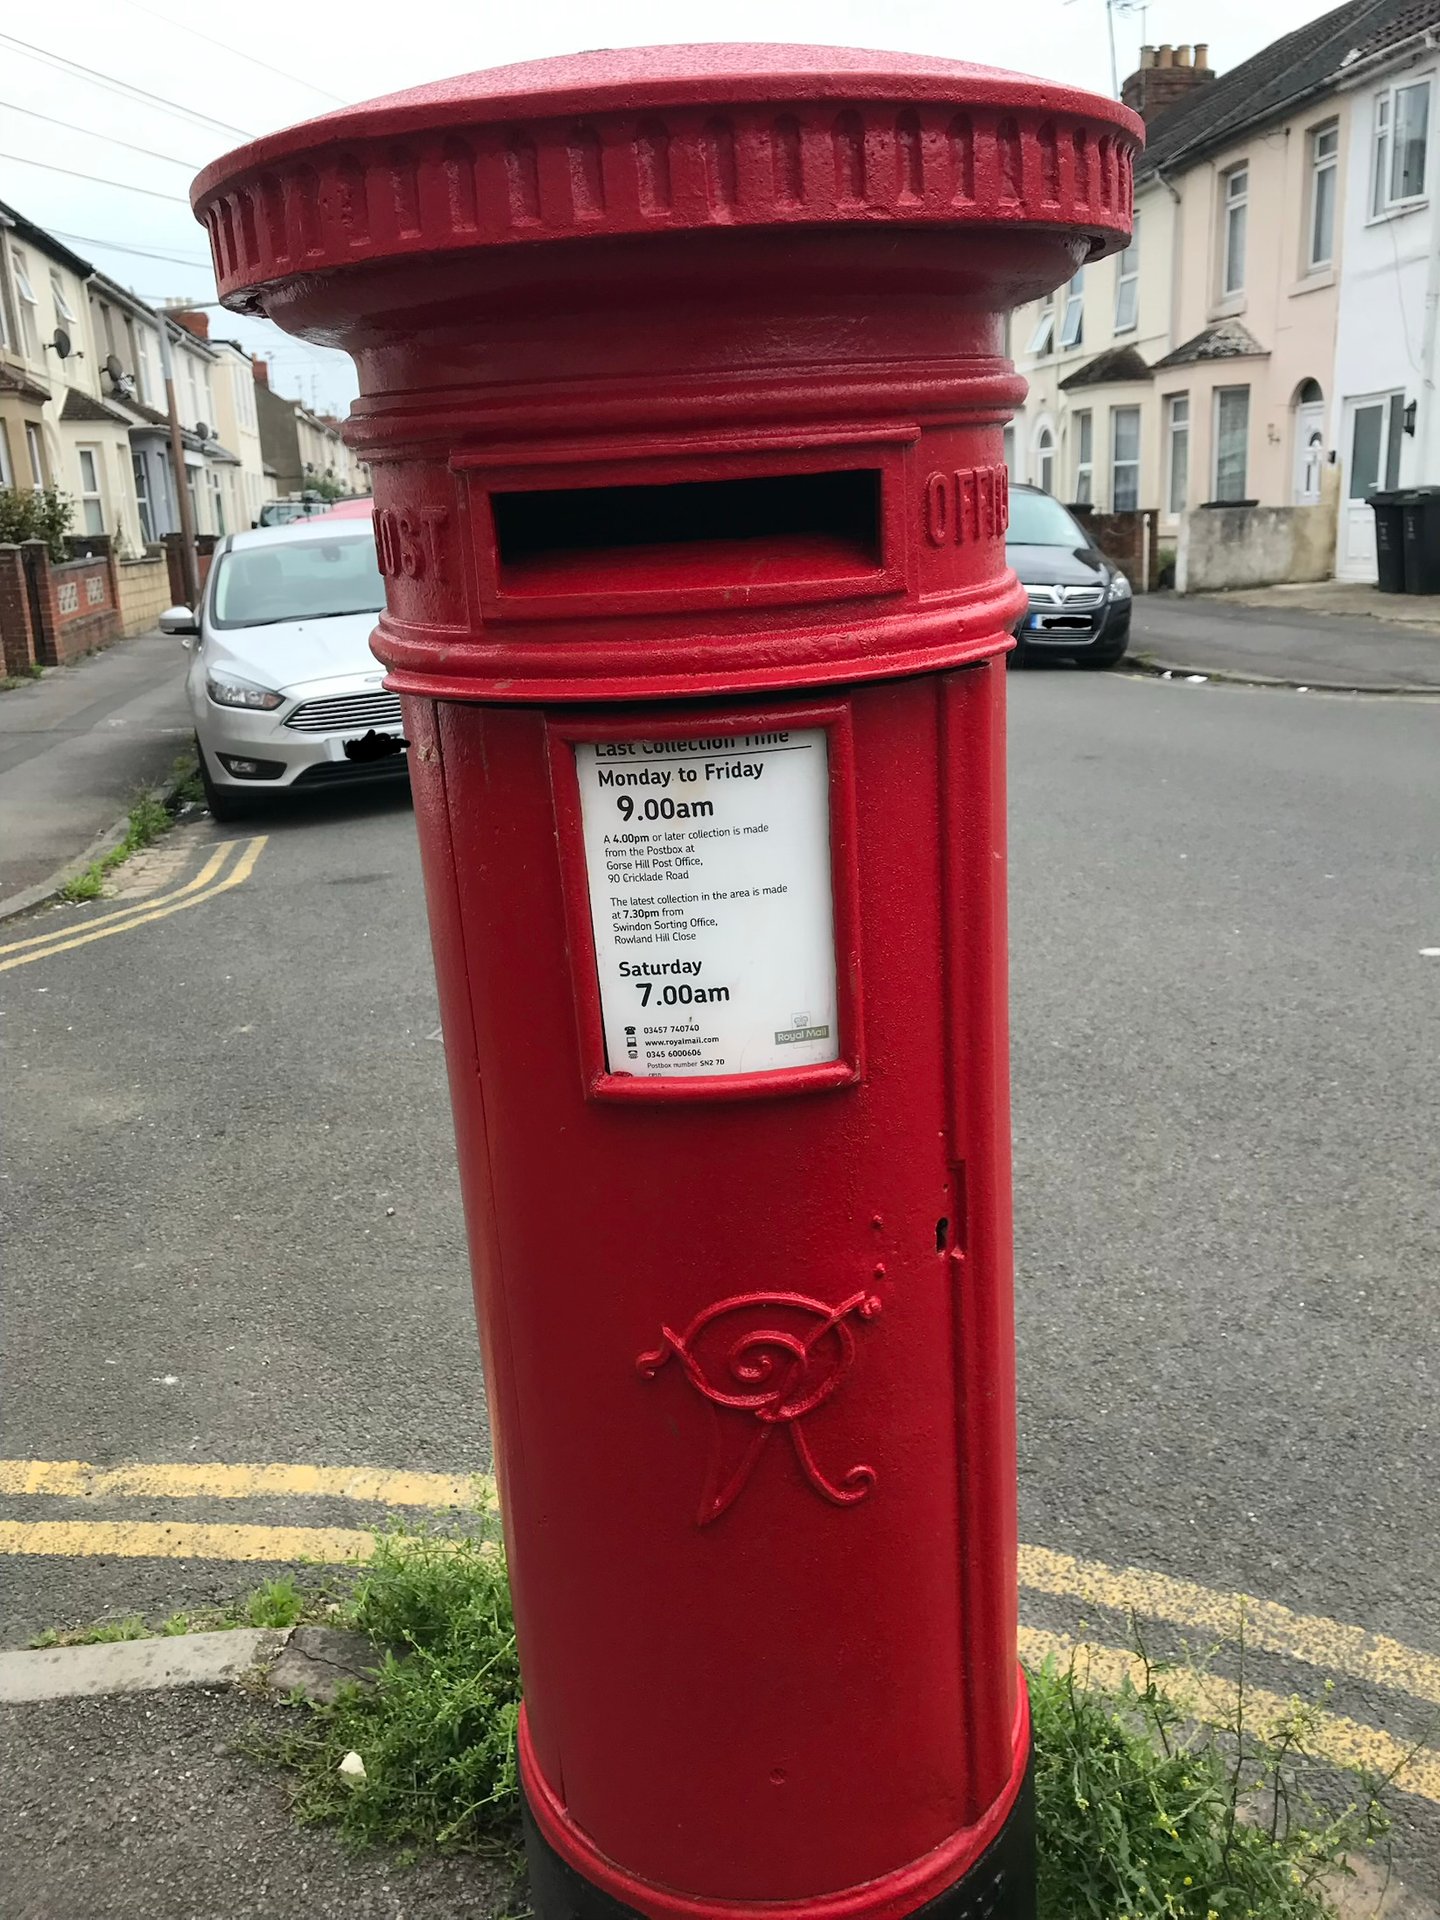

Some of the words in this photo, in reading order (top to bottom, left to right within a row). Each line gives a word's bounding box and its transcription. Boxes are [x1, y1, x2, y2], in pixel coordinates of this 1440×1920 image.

[372, 507, 446, 580] OST
[595, 741, 636, 757] Last
[642, 737, 735, 754] Collection
[598, 768, 671, 788] Monday
[678, 768, 697, 782] to
[705, 761, 764, 781] Friday
[616, 795, 714, 822] 9.00am
[604, 835, 610, 844] A
[613, 834, 650, 845] 4.00pm
[664, 832, 685, 842] later
[688, 828, 730, 840] collection
[733, 826, 740, 835] is
[744, 824, 769, 834] made
[605, 847, 626, 857] from
[630, 846, 644, 856] the
[647, 845, 683, 856] Postbox
[686, 844, 695, 853] at
[606, 860, 632, 870] Gorse
[635, 859, 650, 869] Hill
[652, 858, 672, 868] Post
[608, 874, 620, 884] 90
[622, 872, 664, 882] Cricklade
[666, 870, 689, 880] Road
[610, 897, 628, 906] The
[630, 896, 655, 906] latest
[657, 894, 699, 904] collection
[701, 892, 710, 901] in
[712, 891, 728, 900] the
[730, 889, 750, 899] area
[752, 887, 760, 896] is
[762, 884, 788, 895] made
[612, 912, 621, 920] at
[622, 908, 659, 920] 7.30pm
[662, 907, 684, 917] from
[613, 922, 652, 932] Swindon
[654, 919, 688, 930] Sorting
[614, 934, 652, 944] Rowland
[656, 933, 670, 943] Hill
[672, 931, 696, 942] Close
[618, 958, 702, 977] Saturday
[636, 982, 730, 1007] 7.00am
[643, 1026, 668, 1034] 03457
[670, 1024, 700, 1033] 740740
[778, 1030, 804, 1042] Royal
[806, 1028, 827, 1038] Mail
[644, 1036, 720, 1046] www.royalmail.com
[668, 1049, 702, 1058] 6000606
